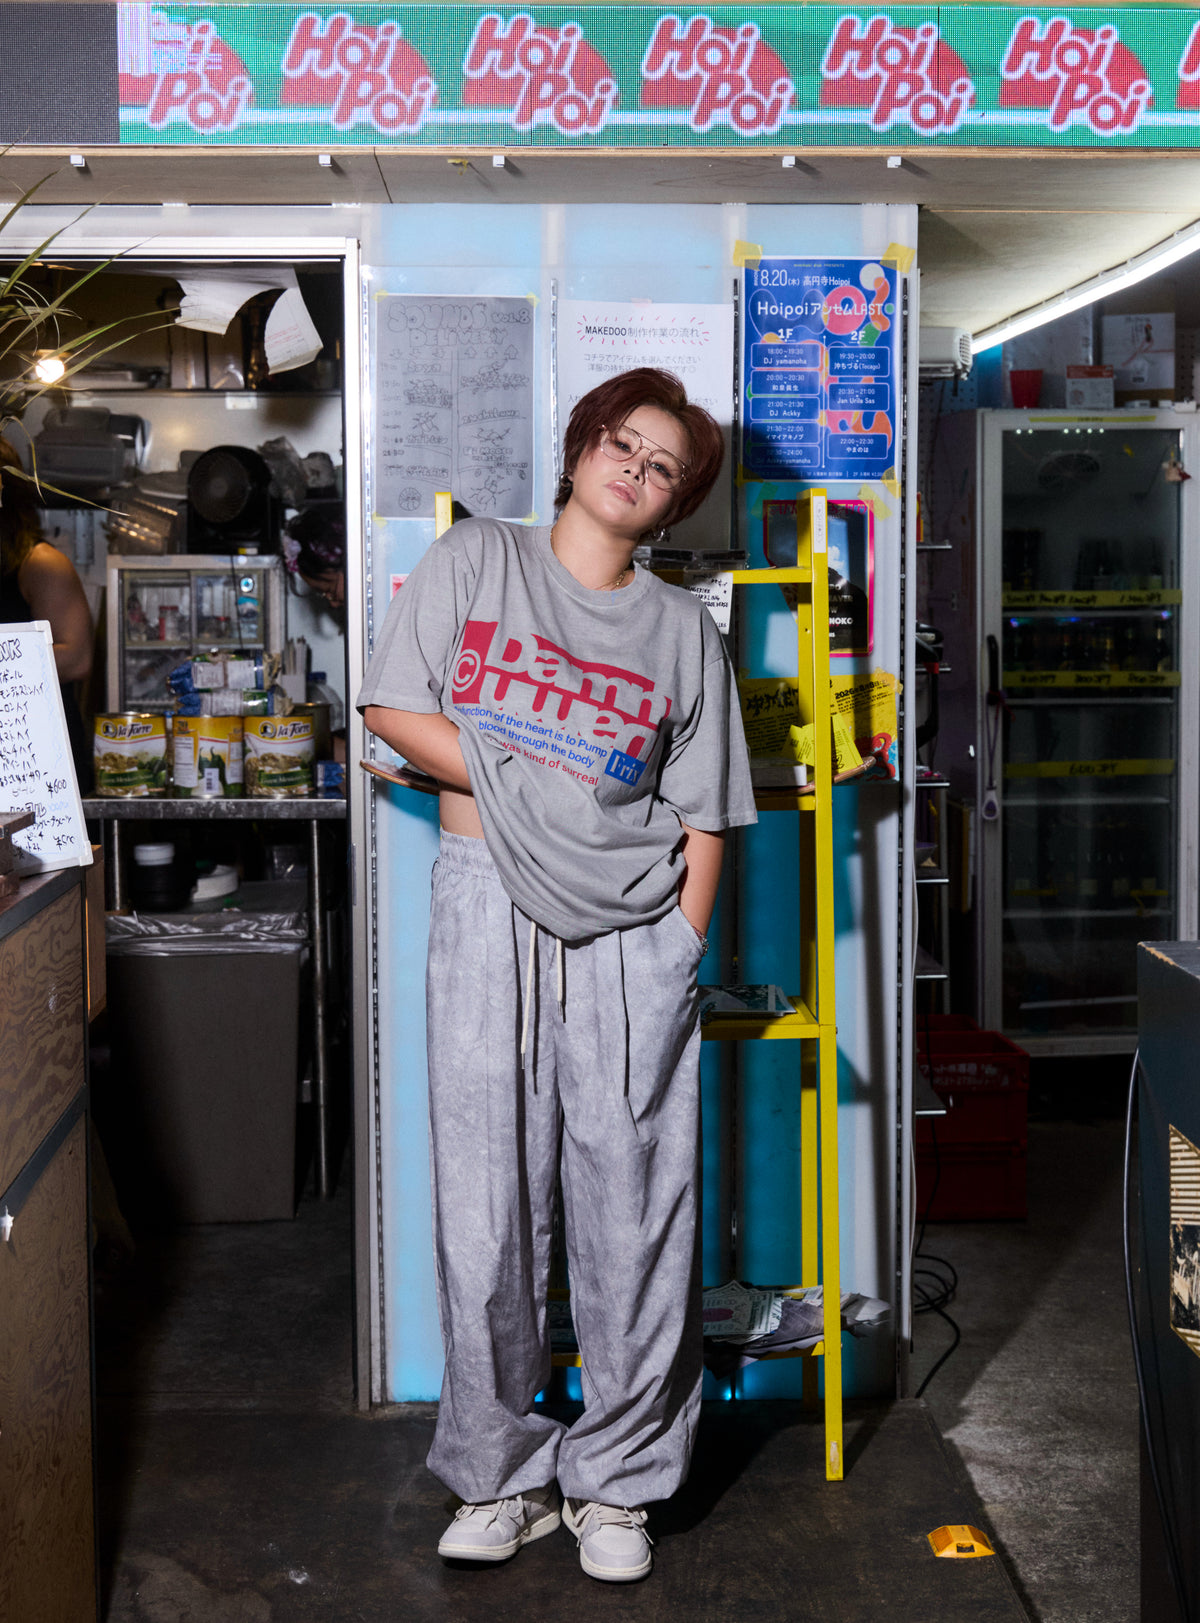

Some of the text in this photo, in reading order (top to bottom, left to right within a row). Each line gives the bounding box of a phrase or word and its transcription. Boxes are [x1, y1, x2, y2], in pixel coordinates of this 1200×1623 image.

[283, 13, 400, 78] Hoi
[463, 14, 583, 78] Hoi
[642, 14, 760, 79] Hoi
[820, 15, 938, 79] Hoi
[1001, 15, 1118, 79] Hoi
[149, 70, 253, 134] Poi
[332, 68, 438, 135] Poi
[513, 68, 619, 135] Poi
[691, 70, 795, 137] Poi
[872, 70, 975, 136] Poi
[1049, 70, 1153, 137] Poi
[778, 328, 793, 339] 1F
[850, 331, 866, 340] 2F
[769, 409, 779, 417] DJ
[118, 722, 152, 738] la Torre
[278, 721, 311, 738] la Torre
[478, 720, 595, 769] blood through the body
[494, 713, 506, 723] of
[506, 715, 523, 728] the
[525, 721, 553, 738] heart
[554, 731, 563, 741] is
[565, 734, 576, 746] to
[577, 739, 608, 758] Pump
[500, 740, 599, 786] was kind of surreal
